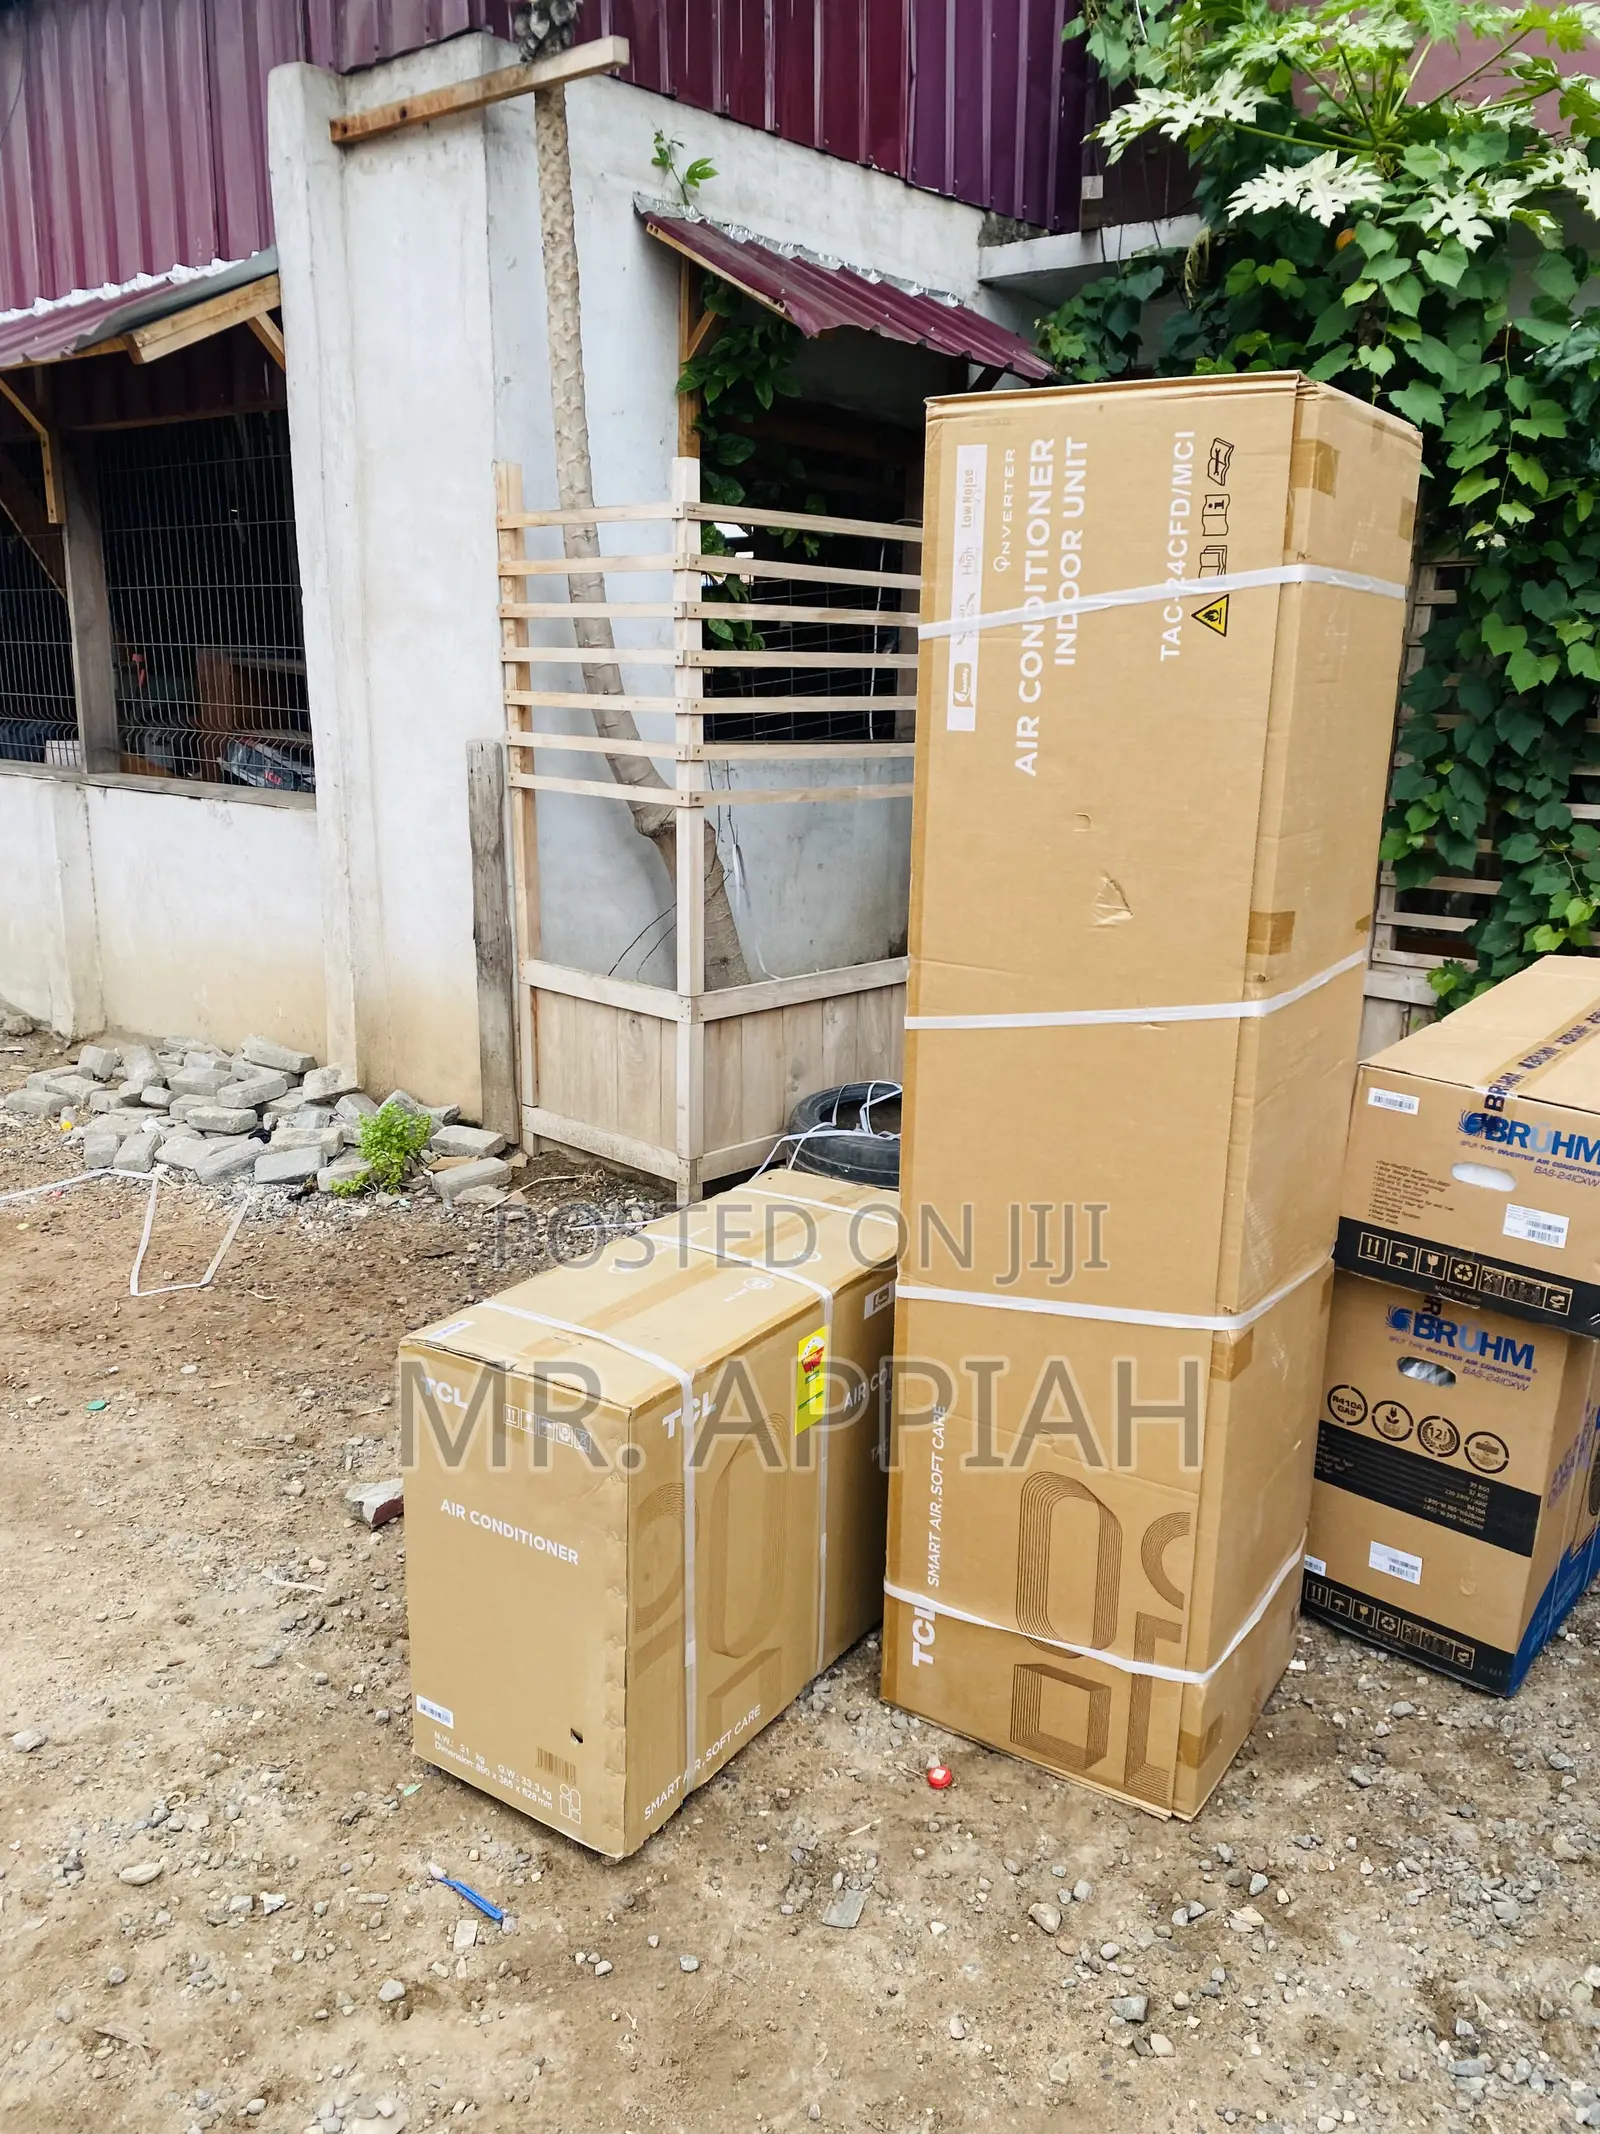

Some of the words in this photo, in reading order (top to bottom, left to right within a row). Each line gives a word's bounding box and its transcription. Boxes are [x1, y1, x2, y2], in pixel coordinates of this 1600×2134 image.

[1062, 435, 1089, 519] UNIT
[961, 506, 972, 528] Low
[1018, 438, 1055, 704] CONDITIONER
[1054, 528, 1084, 666] INDOOR
[1014, 714, 1040, 777] AIR
[420, 1374, 468, 1410] TCL
[843, 1381, 867, 1413] AIR
[1332, 1395, 1363, 1411] R410A
[1337, 1405, 1357, 1417] GAS
[931, 1403, 947, 1450] CARE
[1429, 1427, 1443, 1440] 12
[930, 1451, 945, 1498] SOFT
[440, 1498, 466, 1521] AIR
[469, 1509, 579, 1566] CONDITIONER
[927, 1530, 942, 1588] SMART
[644, 1775, 681, 1821] SMART
[705, 1729, 733, 1762] SOFT
[734, 1703, 761, 1736] CARE
